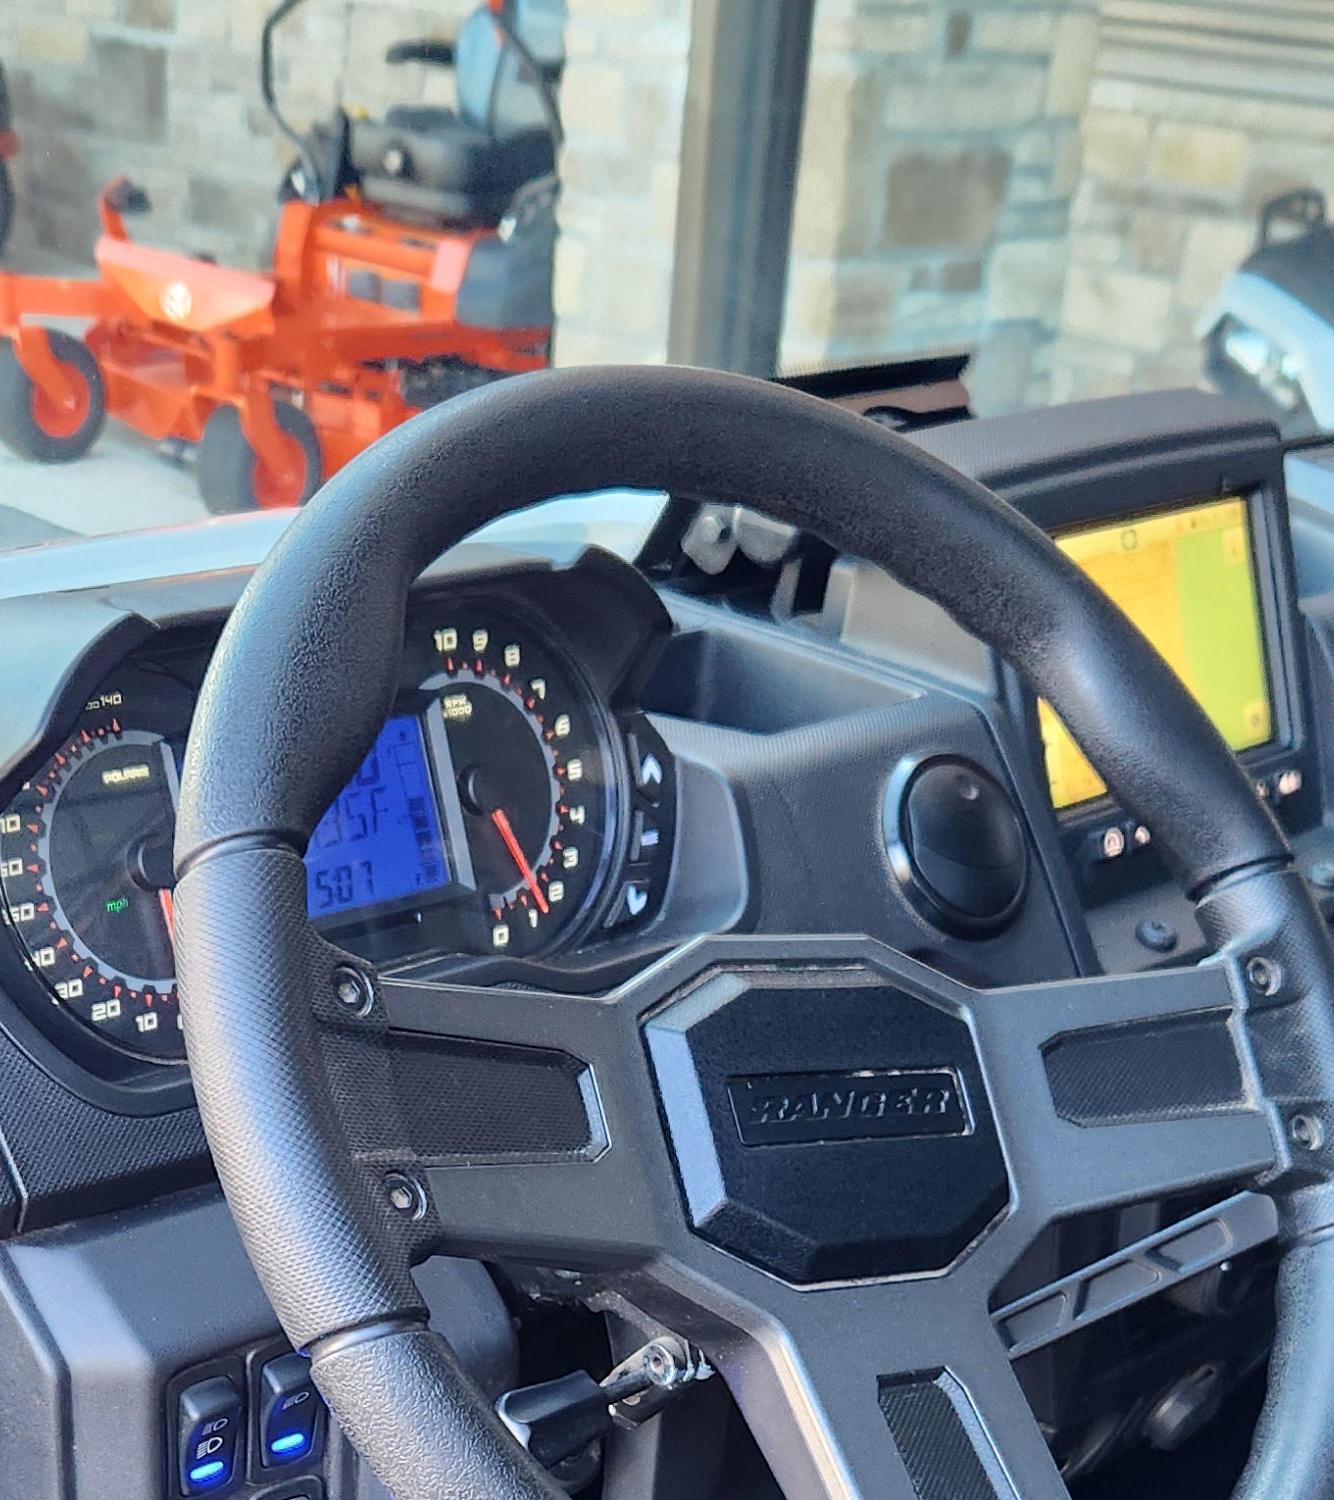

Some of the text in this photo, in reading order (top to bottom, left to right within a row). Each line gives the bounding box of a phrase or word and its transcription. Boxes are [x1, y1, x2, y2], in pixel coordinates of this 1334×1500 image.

[433, 627, 458, 652] 10
[473, 628, 489, 653] 9
[504, 644, 520, 667] 8
[100, 691, 123, 706] 140
[531, 678, 546, 700] 7
[554, 714, 571, 737] 6
[567, 759, 583, 781] 5
[569, 805, 586, 825] 4
[563, 846, 579, 869] 3
[548, 880, 564, 902] 2
[105, 896, 129, 914] mph
[528, 908, 539, 928] 1
[493, 924, 509, 948] 0
[91, 999, 121, 1022] 20
[135, 1012, 158, 1033] 10
